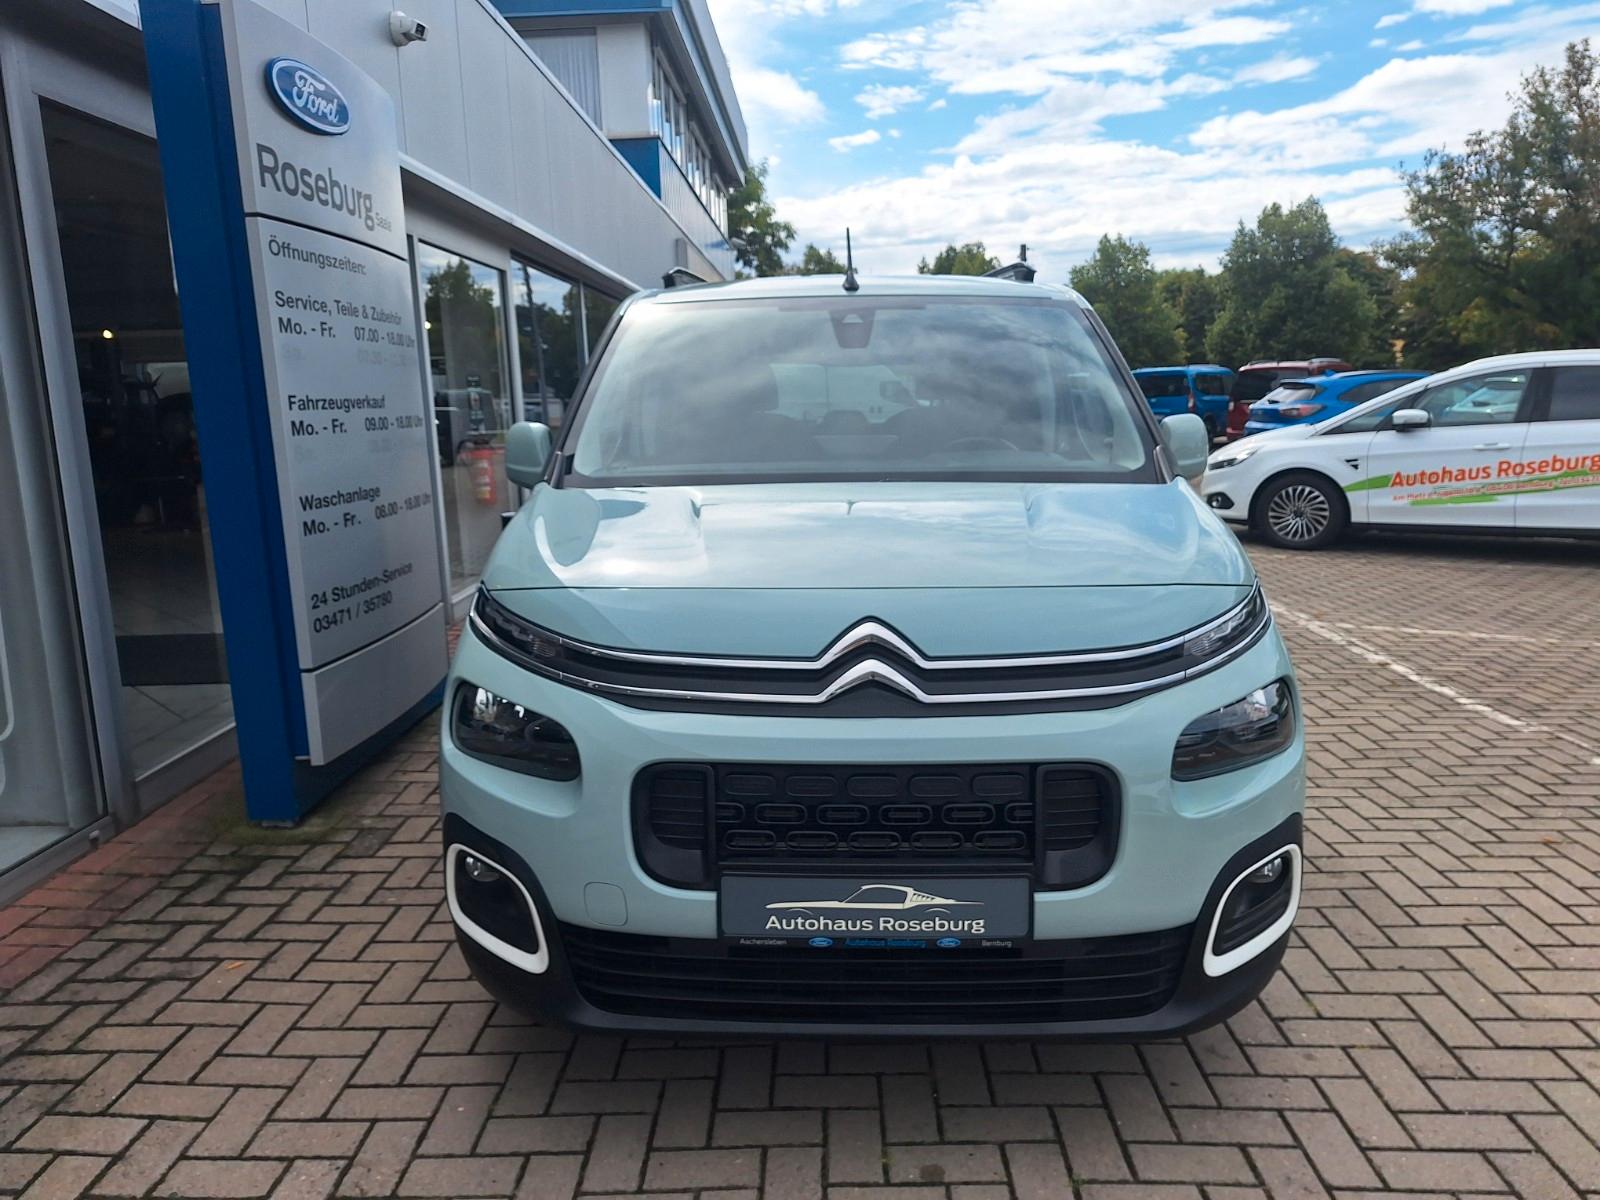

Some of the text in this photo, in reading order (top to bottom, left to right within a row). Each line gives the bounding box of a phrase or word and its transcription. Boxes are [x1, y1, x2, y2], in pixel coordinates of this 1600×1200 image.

[292, 70, 340, 124] Ford
[255, 142, 376, 232] Roseburg
[268, 234, 367, 275] Öffnungszeiten:
[274, 290, 333, 316] Service,
[334, 299, 360, 318] Teile
[361, 305, 370, 320] &
[277, 316, 308, 336] Mo.
[319, 320, 337, 339] Fr.
[354, 325, 380, 344] 07.00
[287, 393, 386, 413] Fahrzeugverkauf
[290, 419, 320, 438] Mo.
[331, 418, 348, 435] Fr.
[364, 416, 389, 432] 09.00
[1390, 453, 1600, 488] Autohaus Roseburg
[299, 486, 381, 512] Waschanlage
[302, 518, 331, 537] Mo.
[343, 511, 362, 528] Fr.
[374, 501, 399, 520] 08.00
[311, 562, 413, 610] 24 Stunden-Service
[312, 606, 352, 634] 03471
[765, 914, 986, 935] Autohaus Roseburg
